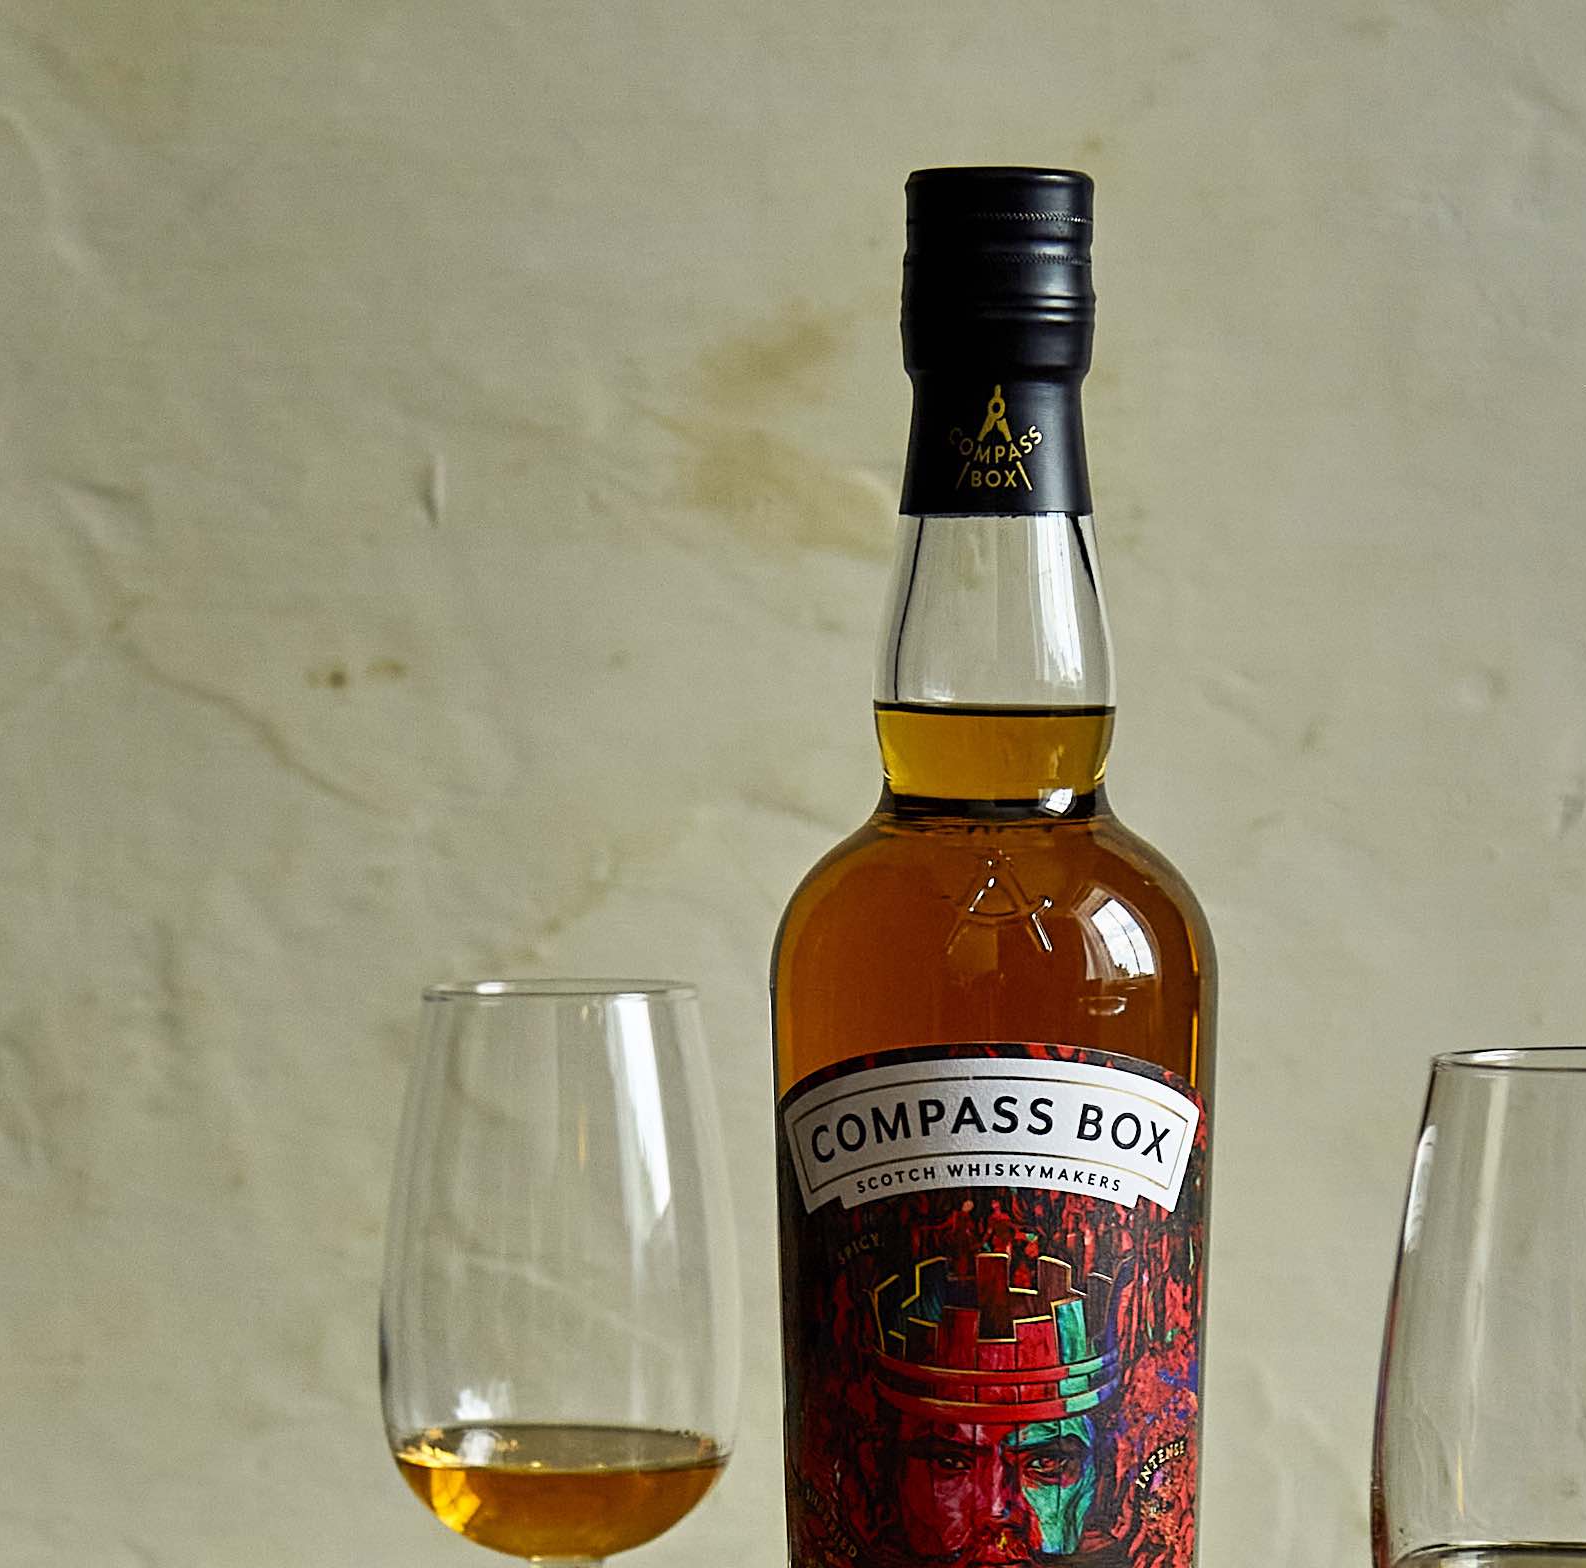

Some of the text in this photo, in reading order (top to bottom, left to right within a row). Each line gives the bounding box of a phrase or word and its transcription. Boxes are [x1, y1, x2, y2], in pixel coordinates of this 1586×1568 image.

[949, 425, 1044, 464] COMPASS
[970, 469, 1018, 488] BOX
[810, 1095, 1171, 1164] COMPASS BOX
[855, 1162, 1122, 1194] SCOTCH WHISKYMAKERS
[1134, 1440, 1186, 1490] INTENSE
